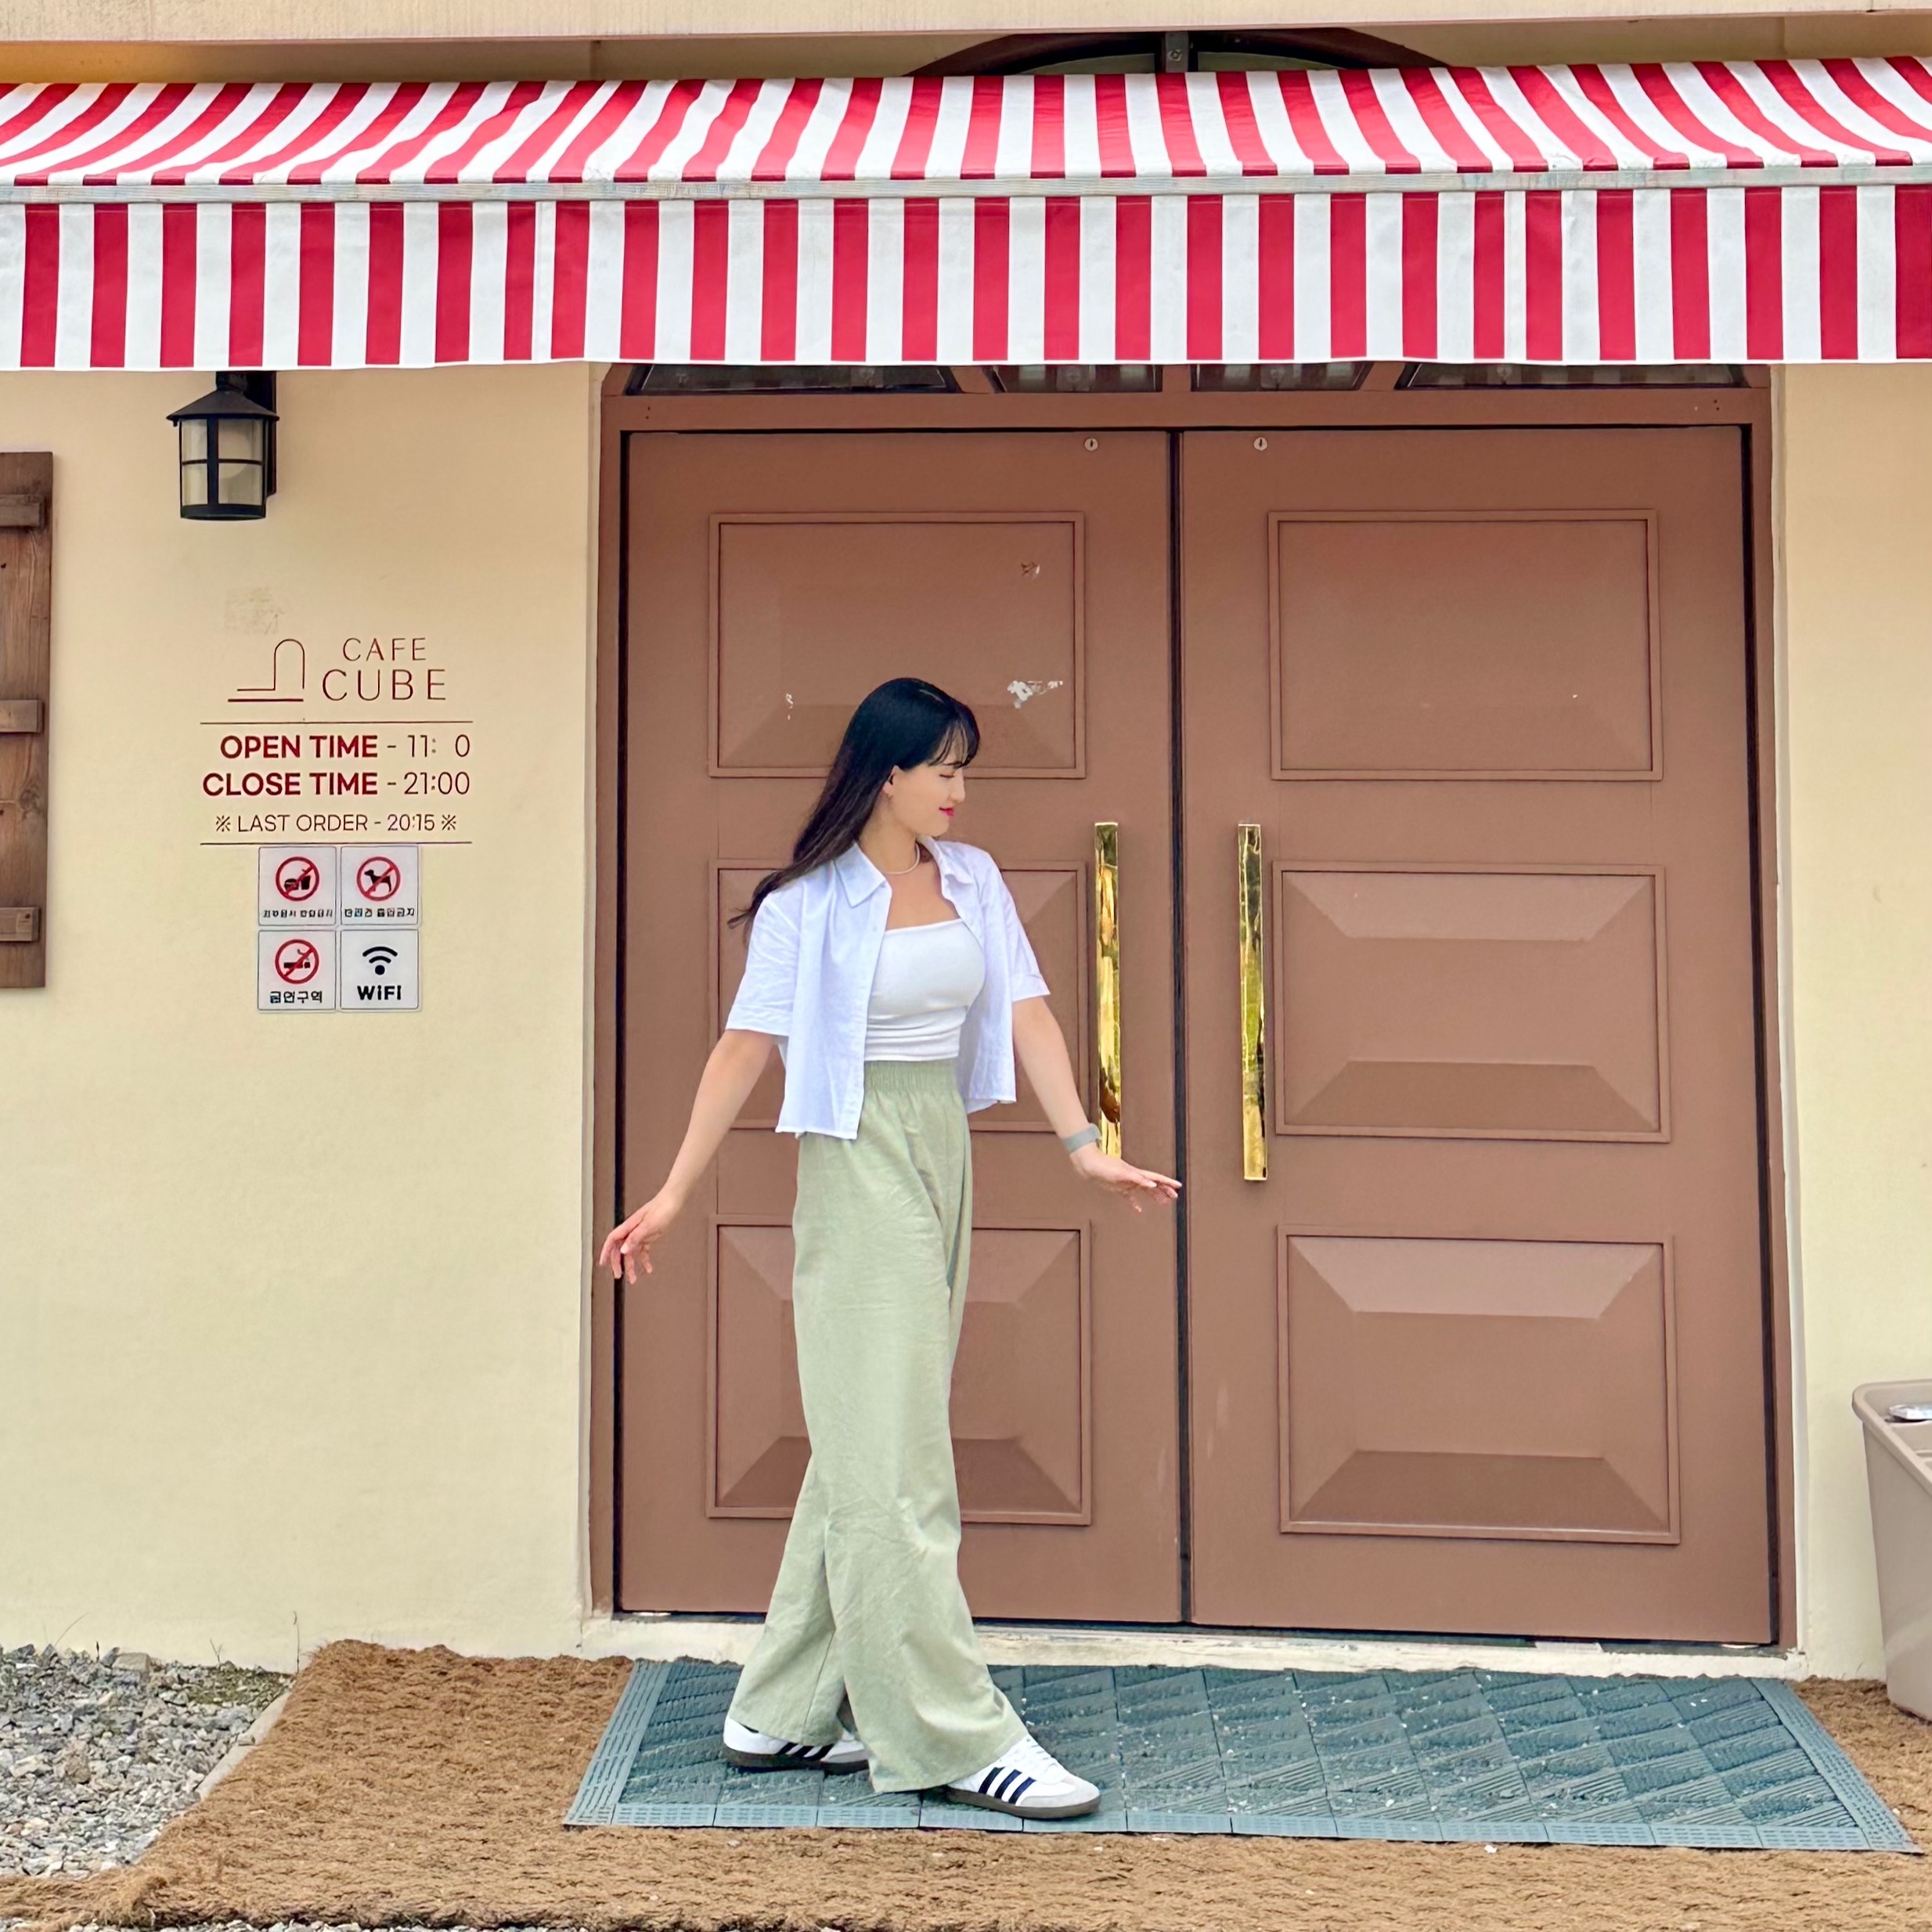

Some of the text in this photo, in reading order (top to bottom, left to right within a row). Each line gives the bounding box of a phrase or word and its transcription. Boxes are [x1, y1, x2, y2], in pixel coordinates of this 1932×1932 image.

[342, 637, 427, 661] CAFE
[322, 669, 447, 701] CUBE
[220, 734, 301, 759] OPEN
[309, 734, 378, 758] TIME
[203, 772, 301, 797] CLOSE
[309, 772, 378, 796] TIME
[404, 771, 470, 795] 21:00
[238, 813, 291, 832] LAST
[296, 814, 369, 832] ORDER
